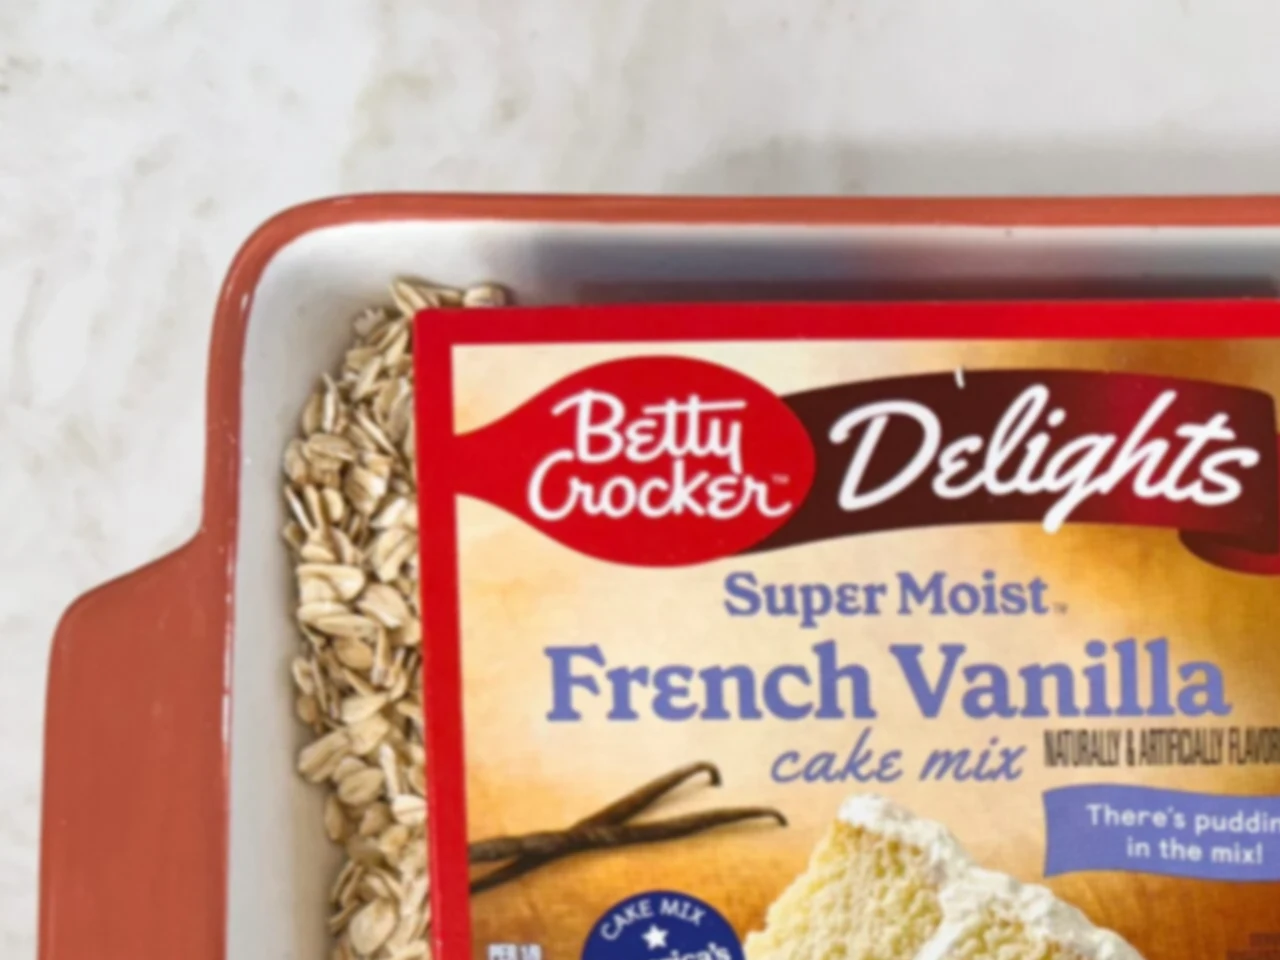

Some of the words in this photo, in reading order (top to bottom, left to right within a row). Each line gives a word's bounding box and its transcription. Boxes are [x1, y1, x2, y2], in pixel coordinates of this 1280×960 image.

[551, 387, 747, 475] Betty
[829, 383, 1261, 534] Delights
[527, 456, 792, 522] Crocker
[723, 570, 888, 629] Super
[895, 569, 1049, 616] Moist
[543, 639, 878, 723] French
[888, 636, 1234, 720] Vanilla
[769, 726, 904, 784] cake
[919, 734, 1027, 783] mix
[1043, 728, 1122, 768] NATURALLY
[1125, 728, 1136, 766] &
[1085, 803, 1187, 830] There's
[1126, 837, 1151, 858] in
[1159, 839, 1203, 862] the
[1210, 843, 1264, 865] mix!
[600, 899, 654, 941] CAKE
[659, 898, 707, 927] MIX
